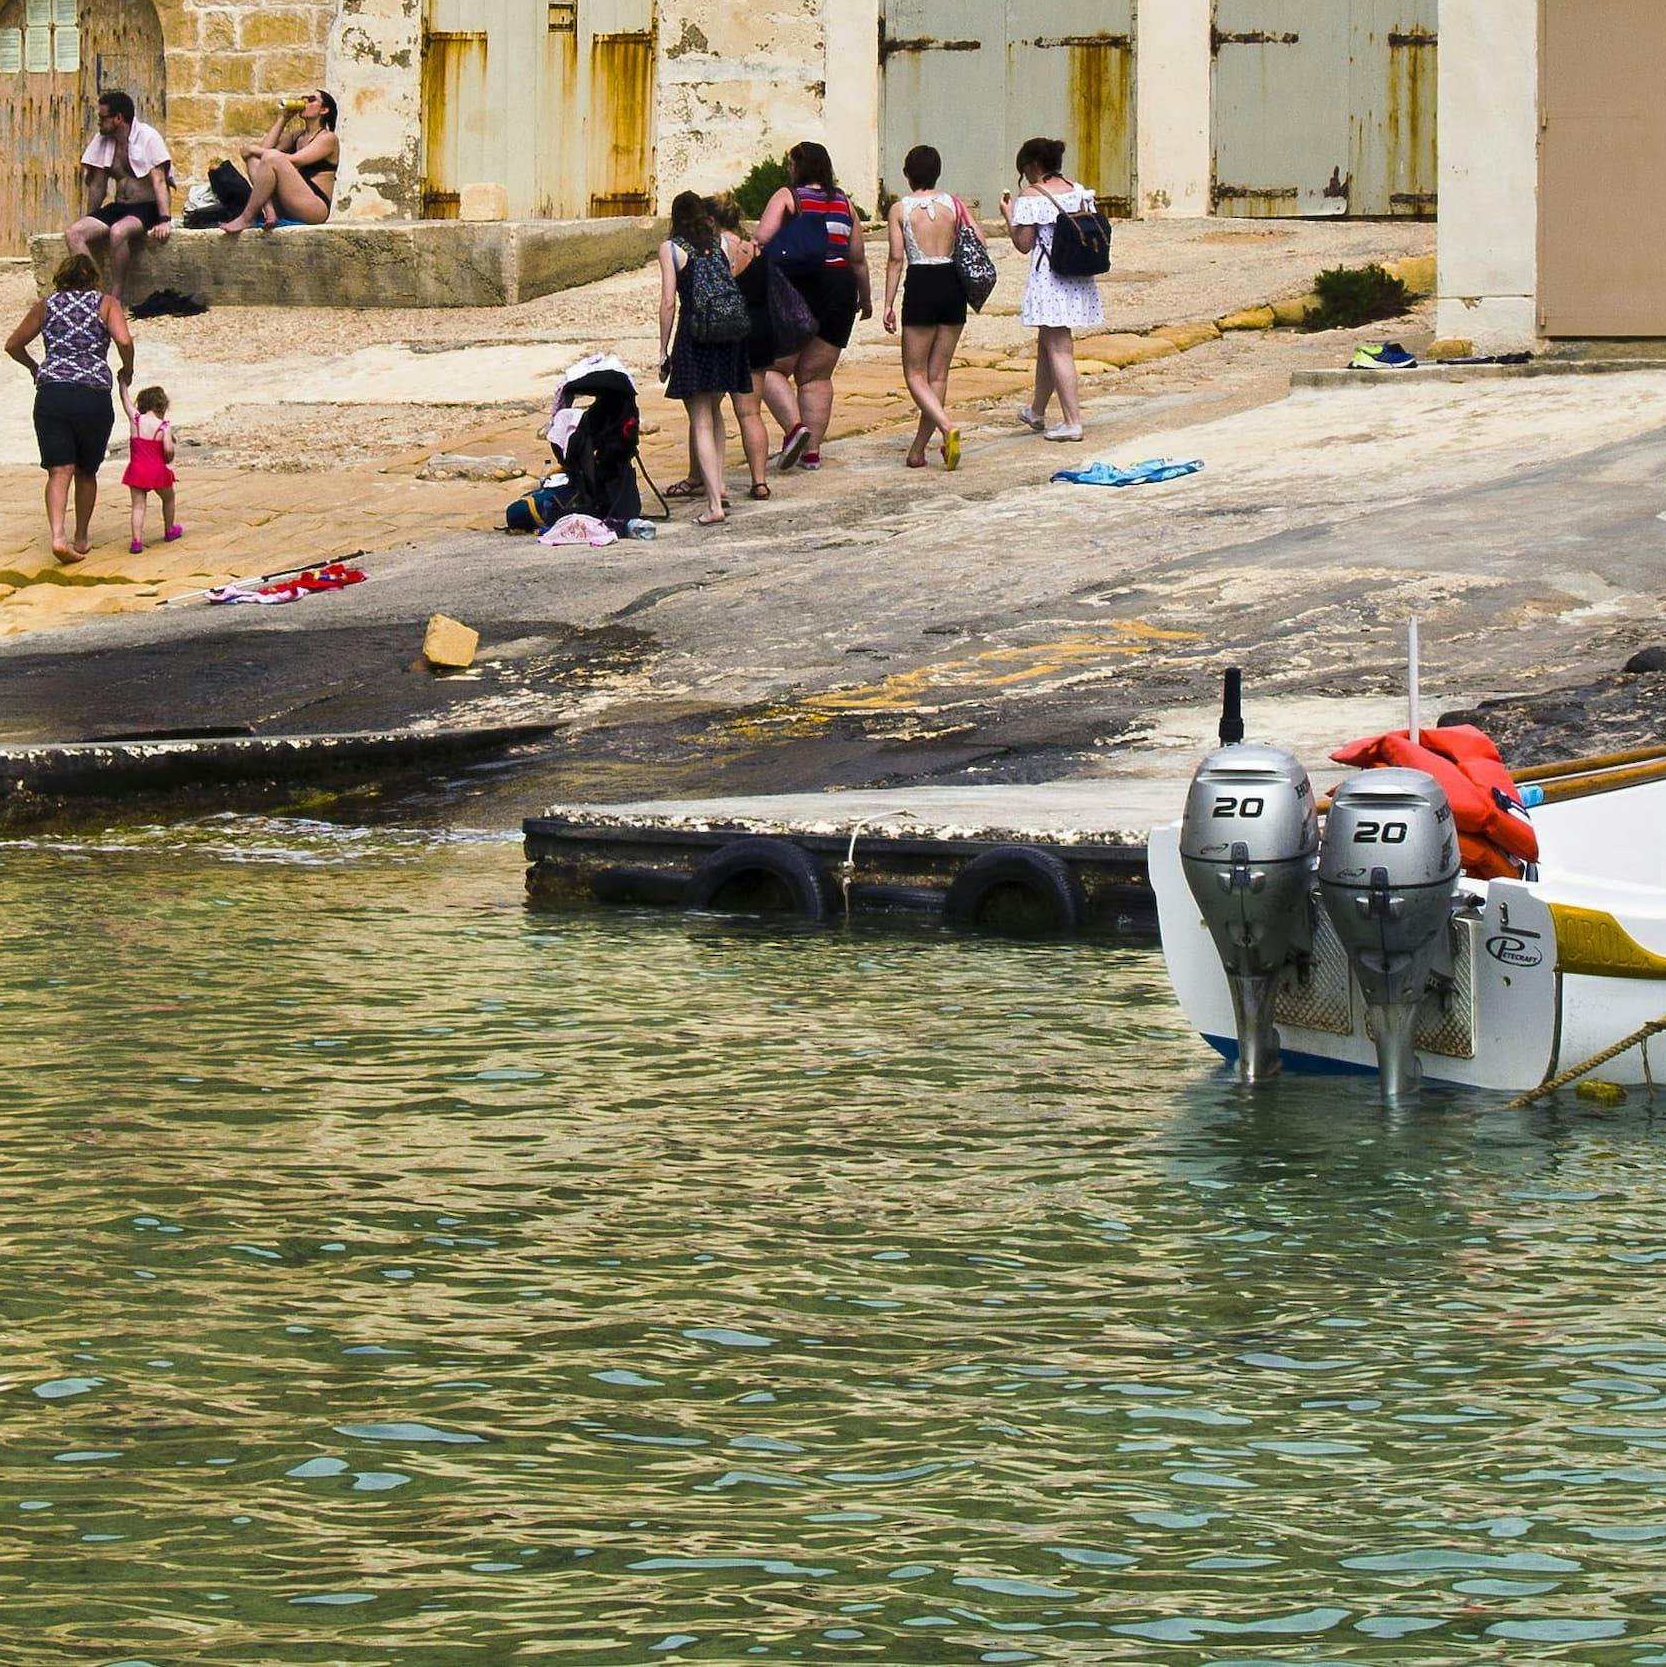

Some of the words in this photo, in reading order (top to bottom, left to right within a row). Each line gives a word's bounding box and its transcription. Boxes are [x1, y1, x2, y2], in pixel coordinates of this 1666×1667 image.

[1212, 796, 1264, 819] 20
[1353, 820, 1408, 844] 20
[1485, 936, 1543, 968] PETECRAFT
